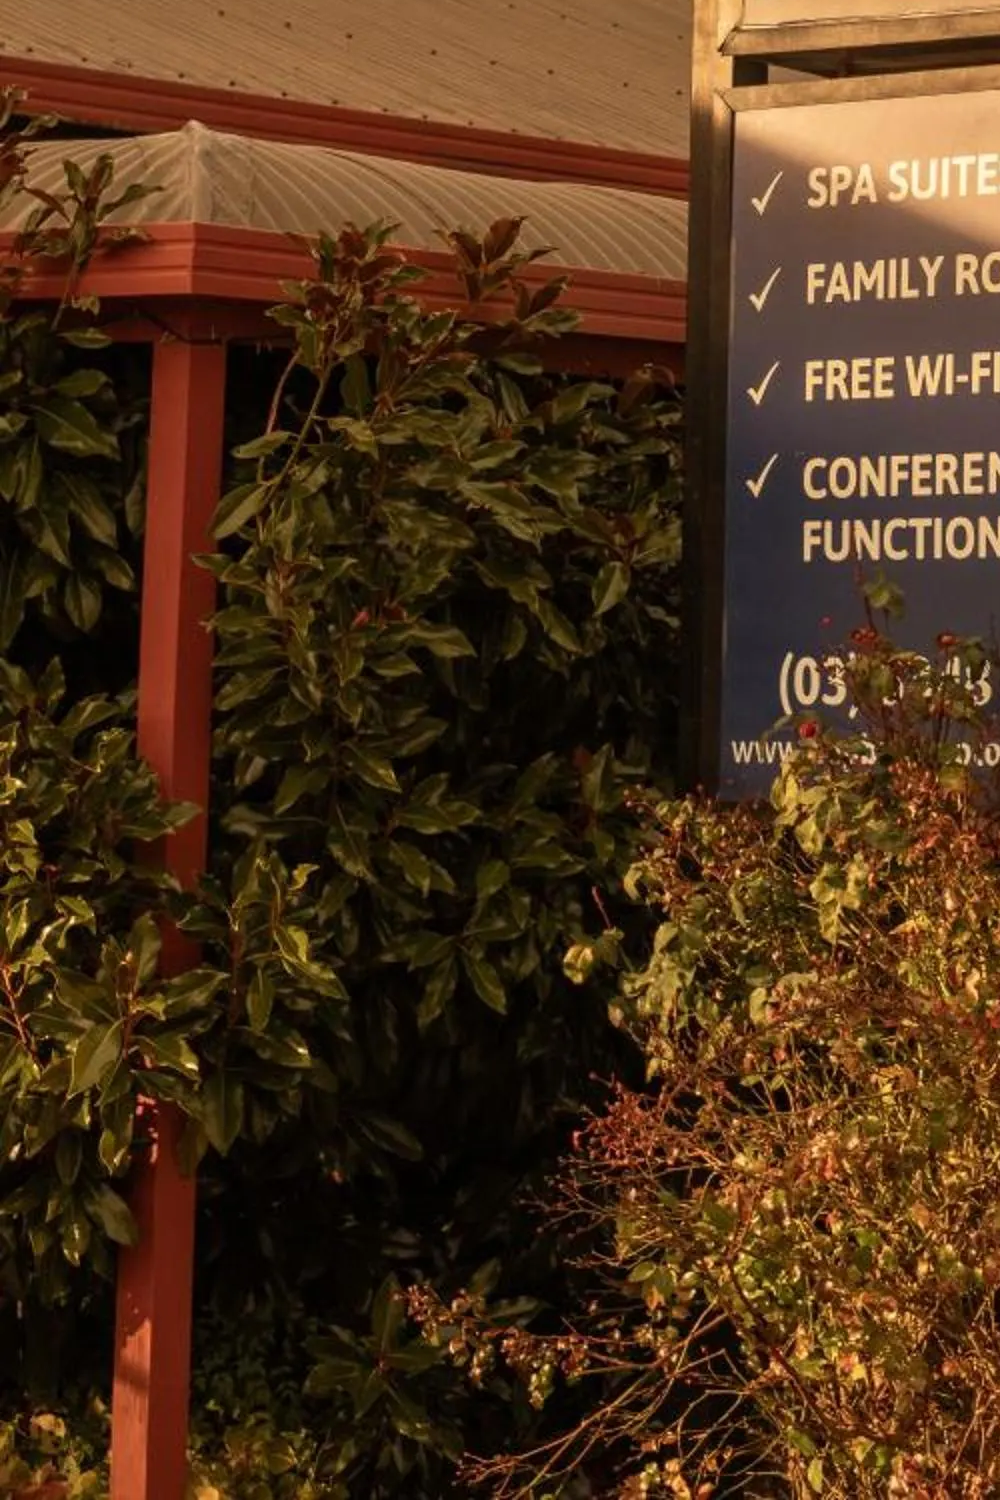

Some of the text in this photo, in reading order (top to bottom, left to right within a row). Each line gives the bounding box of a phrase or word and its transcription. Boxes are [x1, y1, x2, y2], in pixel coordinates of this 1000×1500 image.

[806, 165, 878, 209] SPA
[806, 255, 944, 304] FAMILY
[804, 356, 895, 402] FREE
